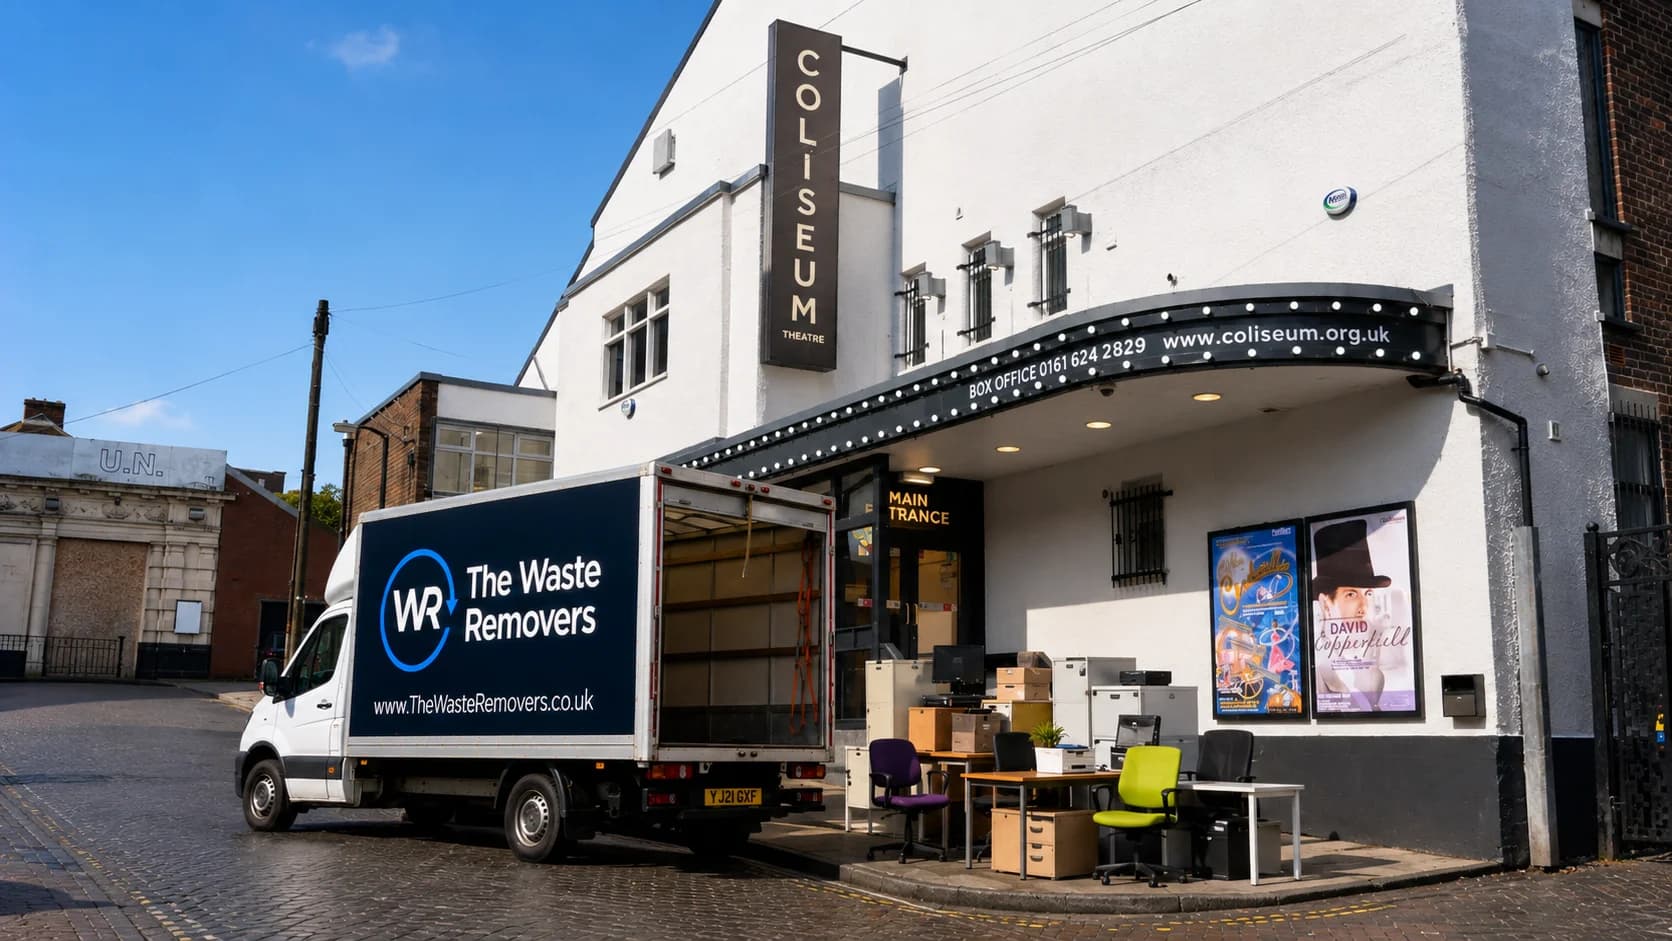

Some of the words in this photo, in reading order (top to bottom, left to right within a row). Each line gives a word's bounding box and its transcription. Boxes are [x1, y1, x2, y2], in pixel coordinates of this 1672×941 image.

[791, 49, 821, 325] COLISEUM
[782, 329, 825, 344] THEATRE
[969, 378, 993, 399] BOX
[994, 364, 1037, 391] OFFICE
[1039, 355, 1068, 377] 0161
[1071, 346, 1098, 367] 624
[1102, 337, 1147, 360] 2829
[1162, 325, 1391, 350] www.coliseum.org.uk
[100, 448, 164, 478] U.N.
[889, 491, 928, 507] MAIN
[466, 564, 512, 599] The
[519, 555, 601, 594] Waste
[393, 585, 443, 632] WR
[464, 603, 597, 642] Removers
[1330, 620, 1368, 635] DAVID
[373, 688, 595, 715] www.TheWasteRemovers.co.uk
[710, 790, 734, 804] YJ21
[736, 789, 757, 804] GXF
